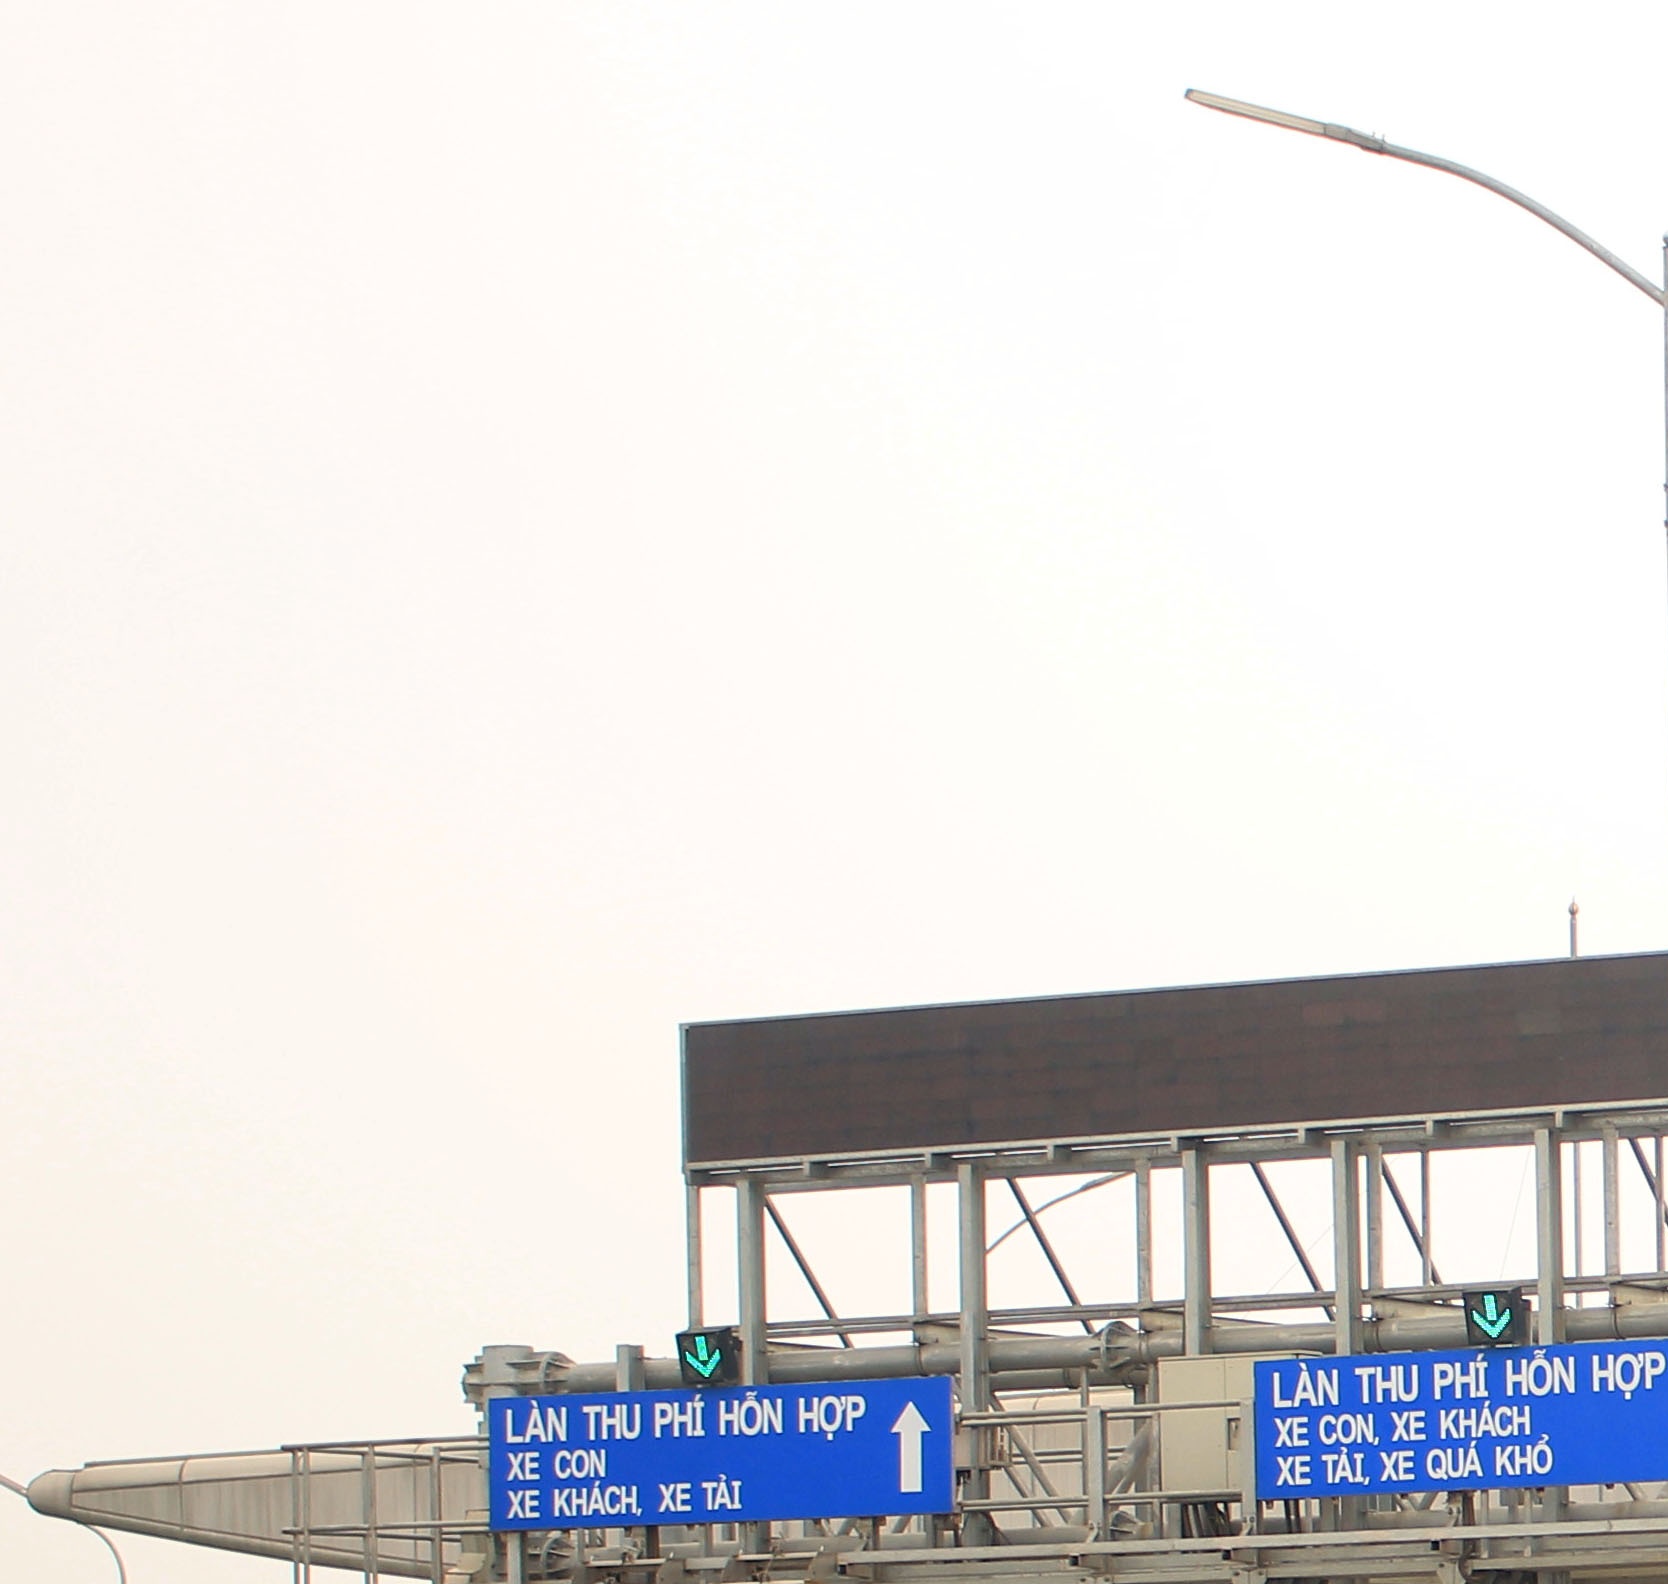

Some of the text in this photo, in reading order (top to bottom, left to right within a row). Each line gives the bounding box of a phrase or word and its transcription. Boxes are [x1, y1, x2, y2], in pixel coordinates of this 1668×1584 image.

[1272, 1349, 1666, 1409] LÀN THU PHÍ HỖN HỢP
[505, 1391, 866, 1444] LÀN THU PHÍ HỖN HỢP
[1275, 1401, 1531, 1448] XE CON, XE KHÁCH
[507, 1449, 606, 1481] XE CON
[1276, 1433, 1554, 1487] XE TẢI, XE QUÁ KHỔ
[507, 1474, 742, 1520] XE KHÁCH, XE TẢI
